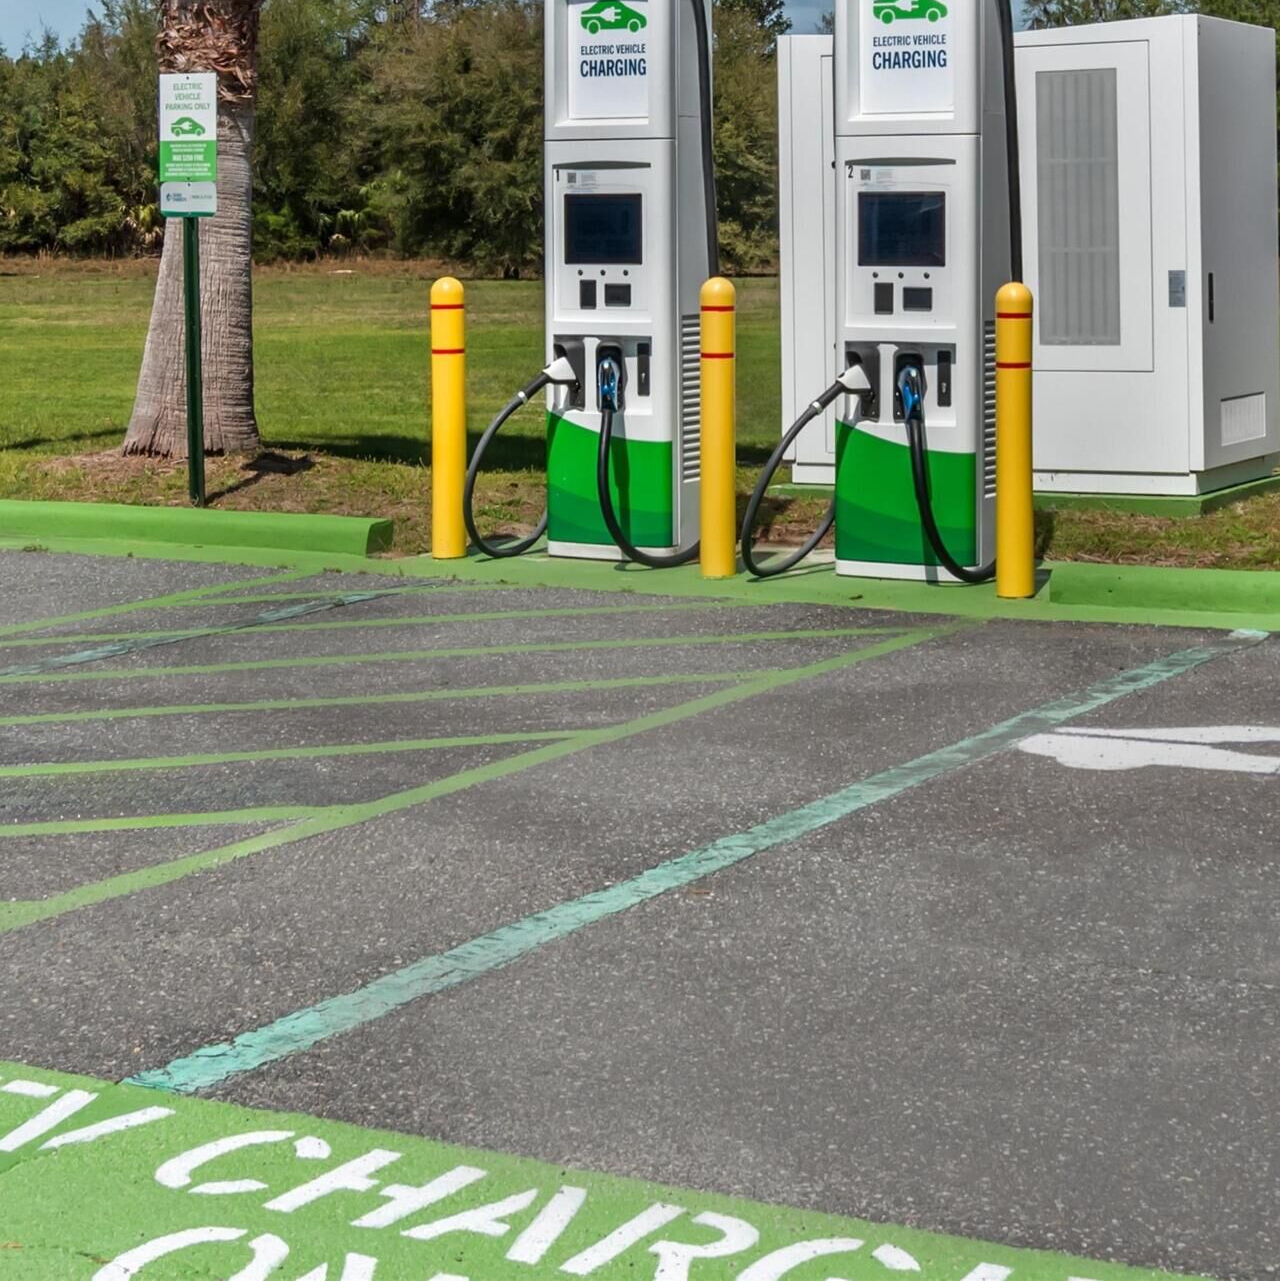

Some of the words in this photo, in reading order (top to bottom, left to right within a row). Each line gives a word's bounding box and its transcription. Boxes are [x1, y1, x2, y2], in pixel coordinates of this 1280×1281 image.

[872, 35, 911, 47] ELECTRIC
[912, 33, 947, 45] VEHICLE
[580, 44, 615, 56] ELECTRIC
[615, 43, 646, 54] VEHICLE
[872, 49, 947, 70] CHARGING
[580, 57, 647, 78] CHARGING
[172, 82, 203, 91] ELECTRIC
[174, 92, 201, 101] VEHICLE
[165, 102, 193, 111] PARKING
[847, 164, 854, 179] 2
[154, 1129, 1095, 1281] CHARG
